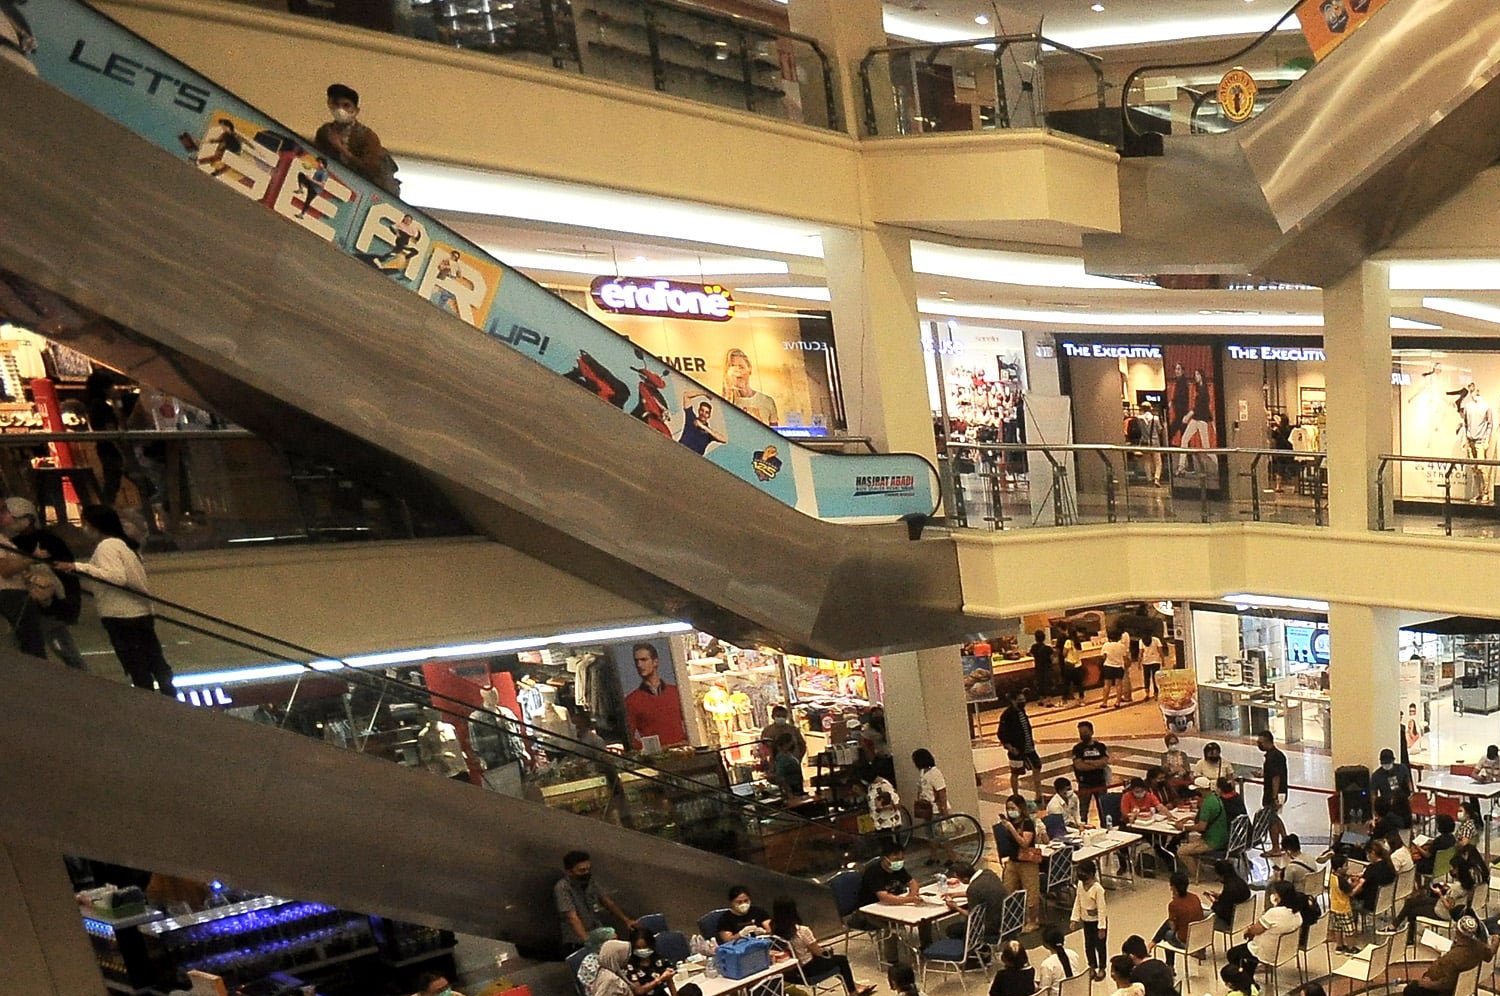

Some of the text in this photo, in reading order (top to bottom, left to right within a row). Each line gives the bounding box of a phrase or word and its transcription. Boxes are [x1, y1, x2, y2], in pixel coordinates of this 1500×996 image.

[68, 38, 211, 114] LET'S
[600, 280, 731, 317] erafone
[487, 317, 551, 356] UP!
[1063, 343, 1091, 357] THE
[1093, 345, 1162, 358] EXECUTIVE
[1228, 345, 1259, 360] THE
[657, 356, 706, 372] MER
